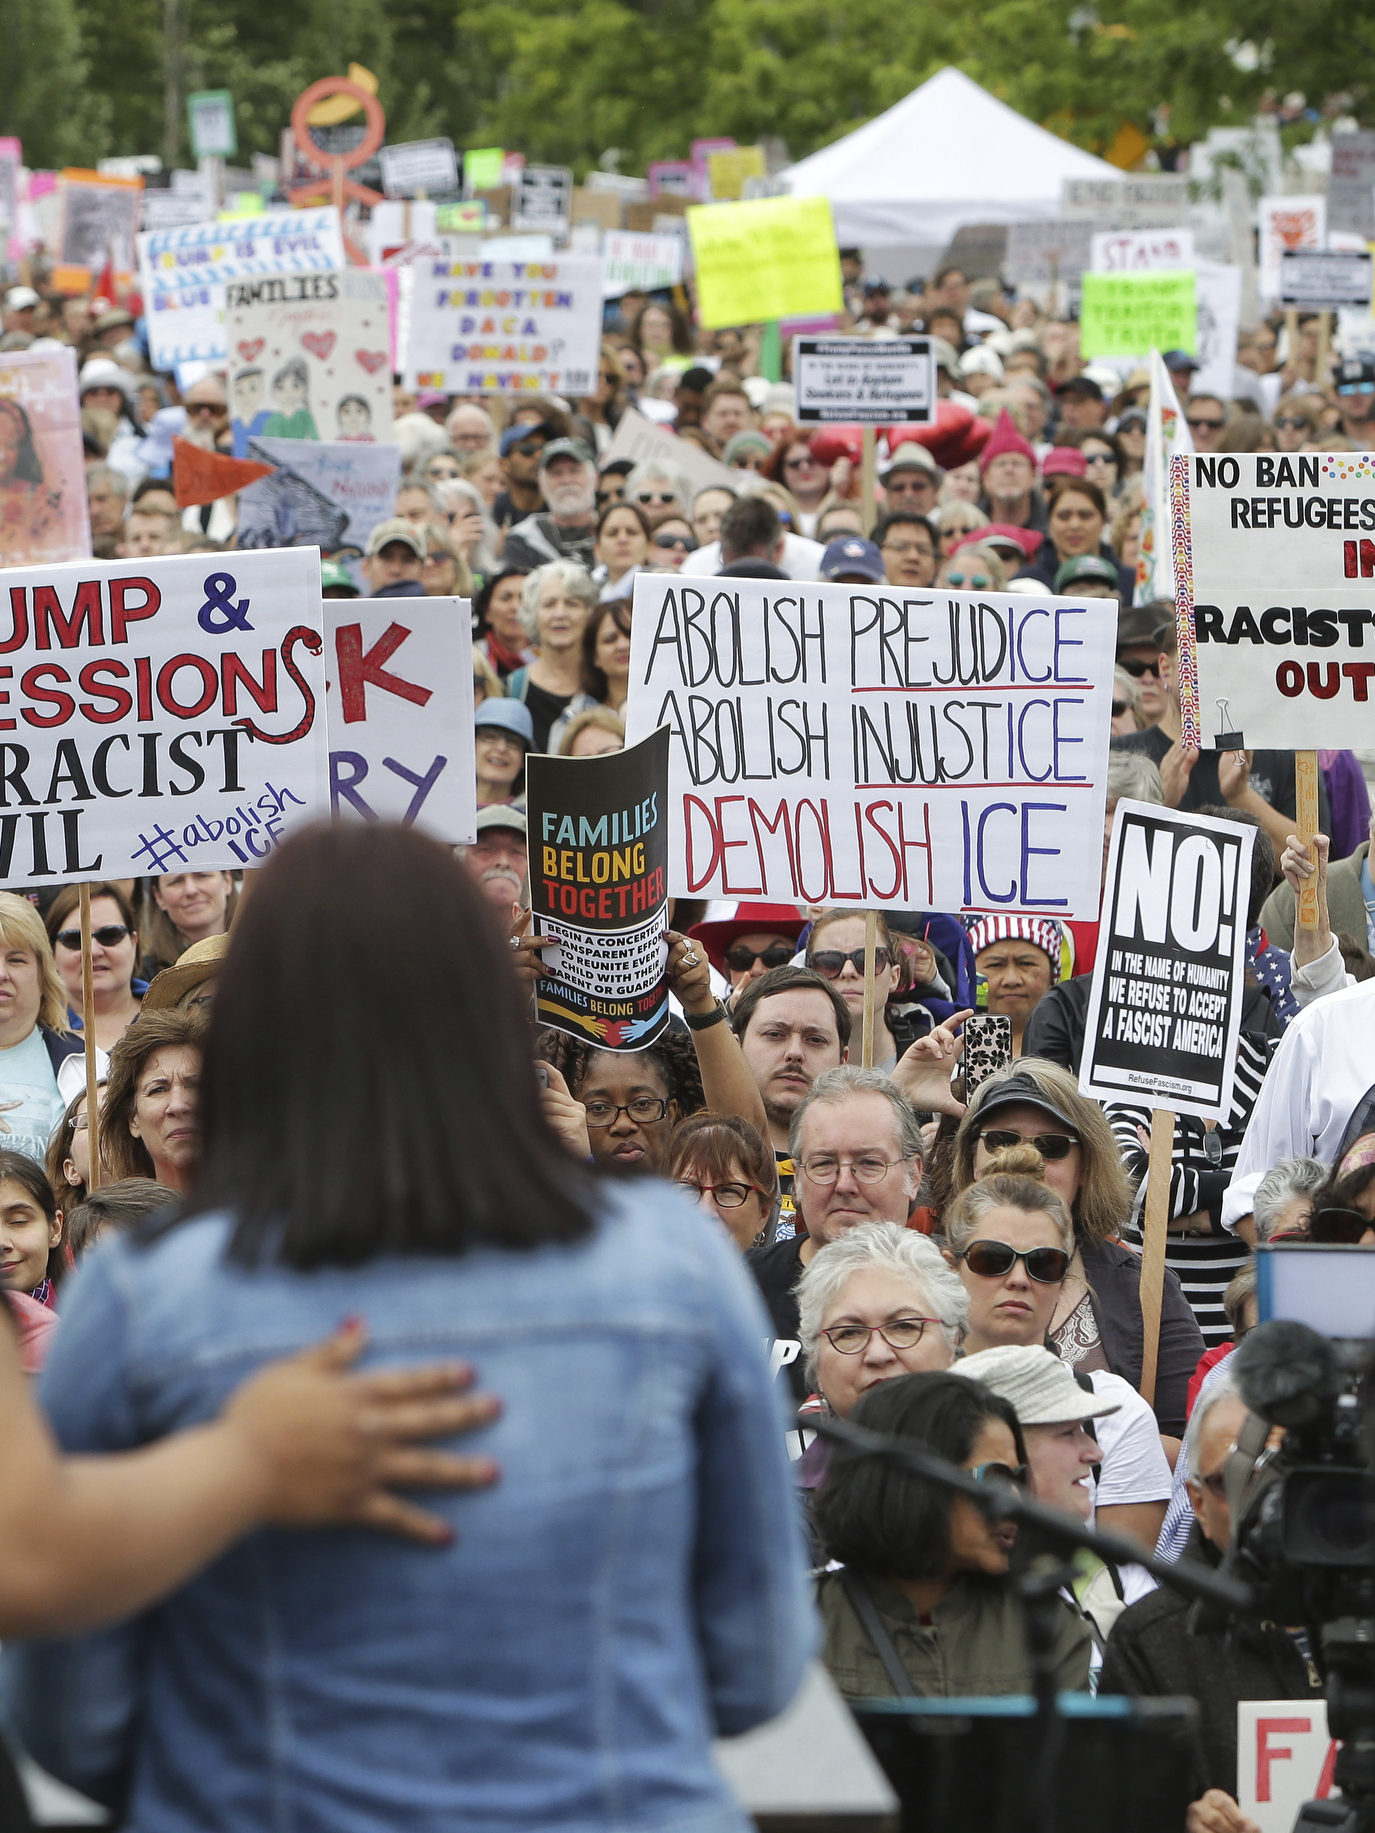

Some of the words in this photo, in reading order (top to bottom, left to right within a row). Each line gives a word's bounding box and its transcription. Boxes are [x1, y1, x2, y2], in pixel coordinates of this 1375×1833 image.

[273, 235, 322, 256] EVIL
[434, 262, 492, 278] HAVE
[513, 262, 559, 279] YOU
[227, 274, 339, 309] FAMILIES
[460, 317, 537, 335] DACA
[417, 371, 445, 388] WE
[1195, 456, 1240, 489] NO
[1255, 456, 1320, 488] BAN
[1230, 496, 1375, 532] REFUGEES
[197, 571, 255, 635] &
[643, 586, 828, 688] ABOLISH
[849, 595, 1089, 688] PREJUDICE
[1193, 604, 1375, 648] RACIST
[1275, 660, 1375, 703] OUT
[656, 690, 831, 787] ABOLISH
[851, 697, 1089, 784] INJUSTICE
[130, 780, 306, 872] #abolish
[542, 790, 659, 847] FAMILIES
[542, 842, 646, 884] BELONG
[682, 793, 934, 906] DEMOLISH
[960, 800, 1070, 906] ICE
[542, 865, 665, 920] TOGETHER
[1113, 822, 1239, 958] NO!
[547, 923, 582, 943] BEGIN
[585, 936, 594, 946] A
[597, 921, 659, 948] CONCERTED
[548, 933, 635, 960] RANSPARENT
[559, 948, 574, 961] TO
[576, 956, 630, 972] REUNITE
[632, 945, 661, 969] EVERY
[561, 960, 594, 980] CHILD
[597, 972, 631, 984] WITH
[634, 959, 660, 980] THEIR
[1111, 949, 1123, 972] IN
[1124, 951, 1144, 976] THE
[1144, 955, 1172, 980] NAME
[1173, 960, 1187, 983] OF
[1186, 962, 1230, 992] HUMANITY
[540, 979, 588, 1008] FAMILIES
[590, 998, 634, 1016] BELONG
[636, 983, 666, 1013] TOGETH
[594, 984, 613, 995] OR
[616, 964, 665, 996] GUARDIAN
[1108, 975, 1126, 1004] WE
[1127, 979, 1171, 1012] REFUSE
[1172, 986, 1188, 1015] TO
[1187, 990, 1227, 1022] ACCEPT
[1101, 1006, 1114, 1040] A
[1116, 1008, 1172, 1048] FASCIST
[1171, 1018, 1224, 1059] AMERICA
[1128, 1073, 1193, 1095] RefuseFascism.org
